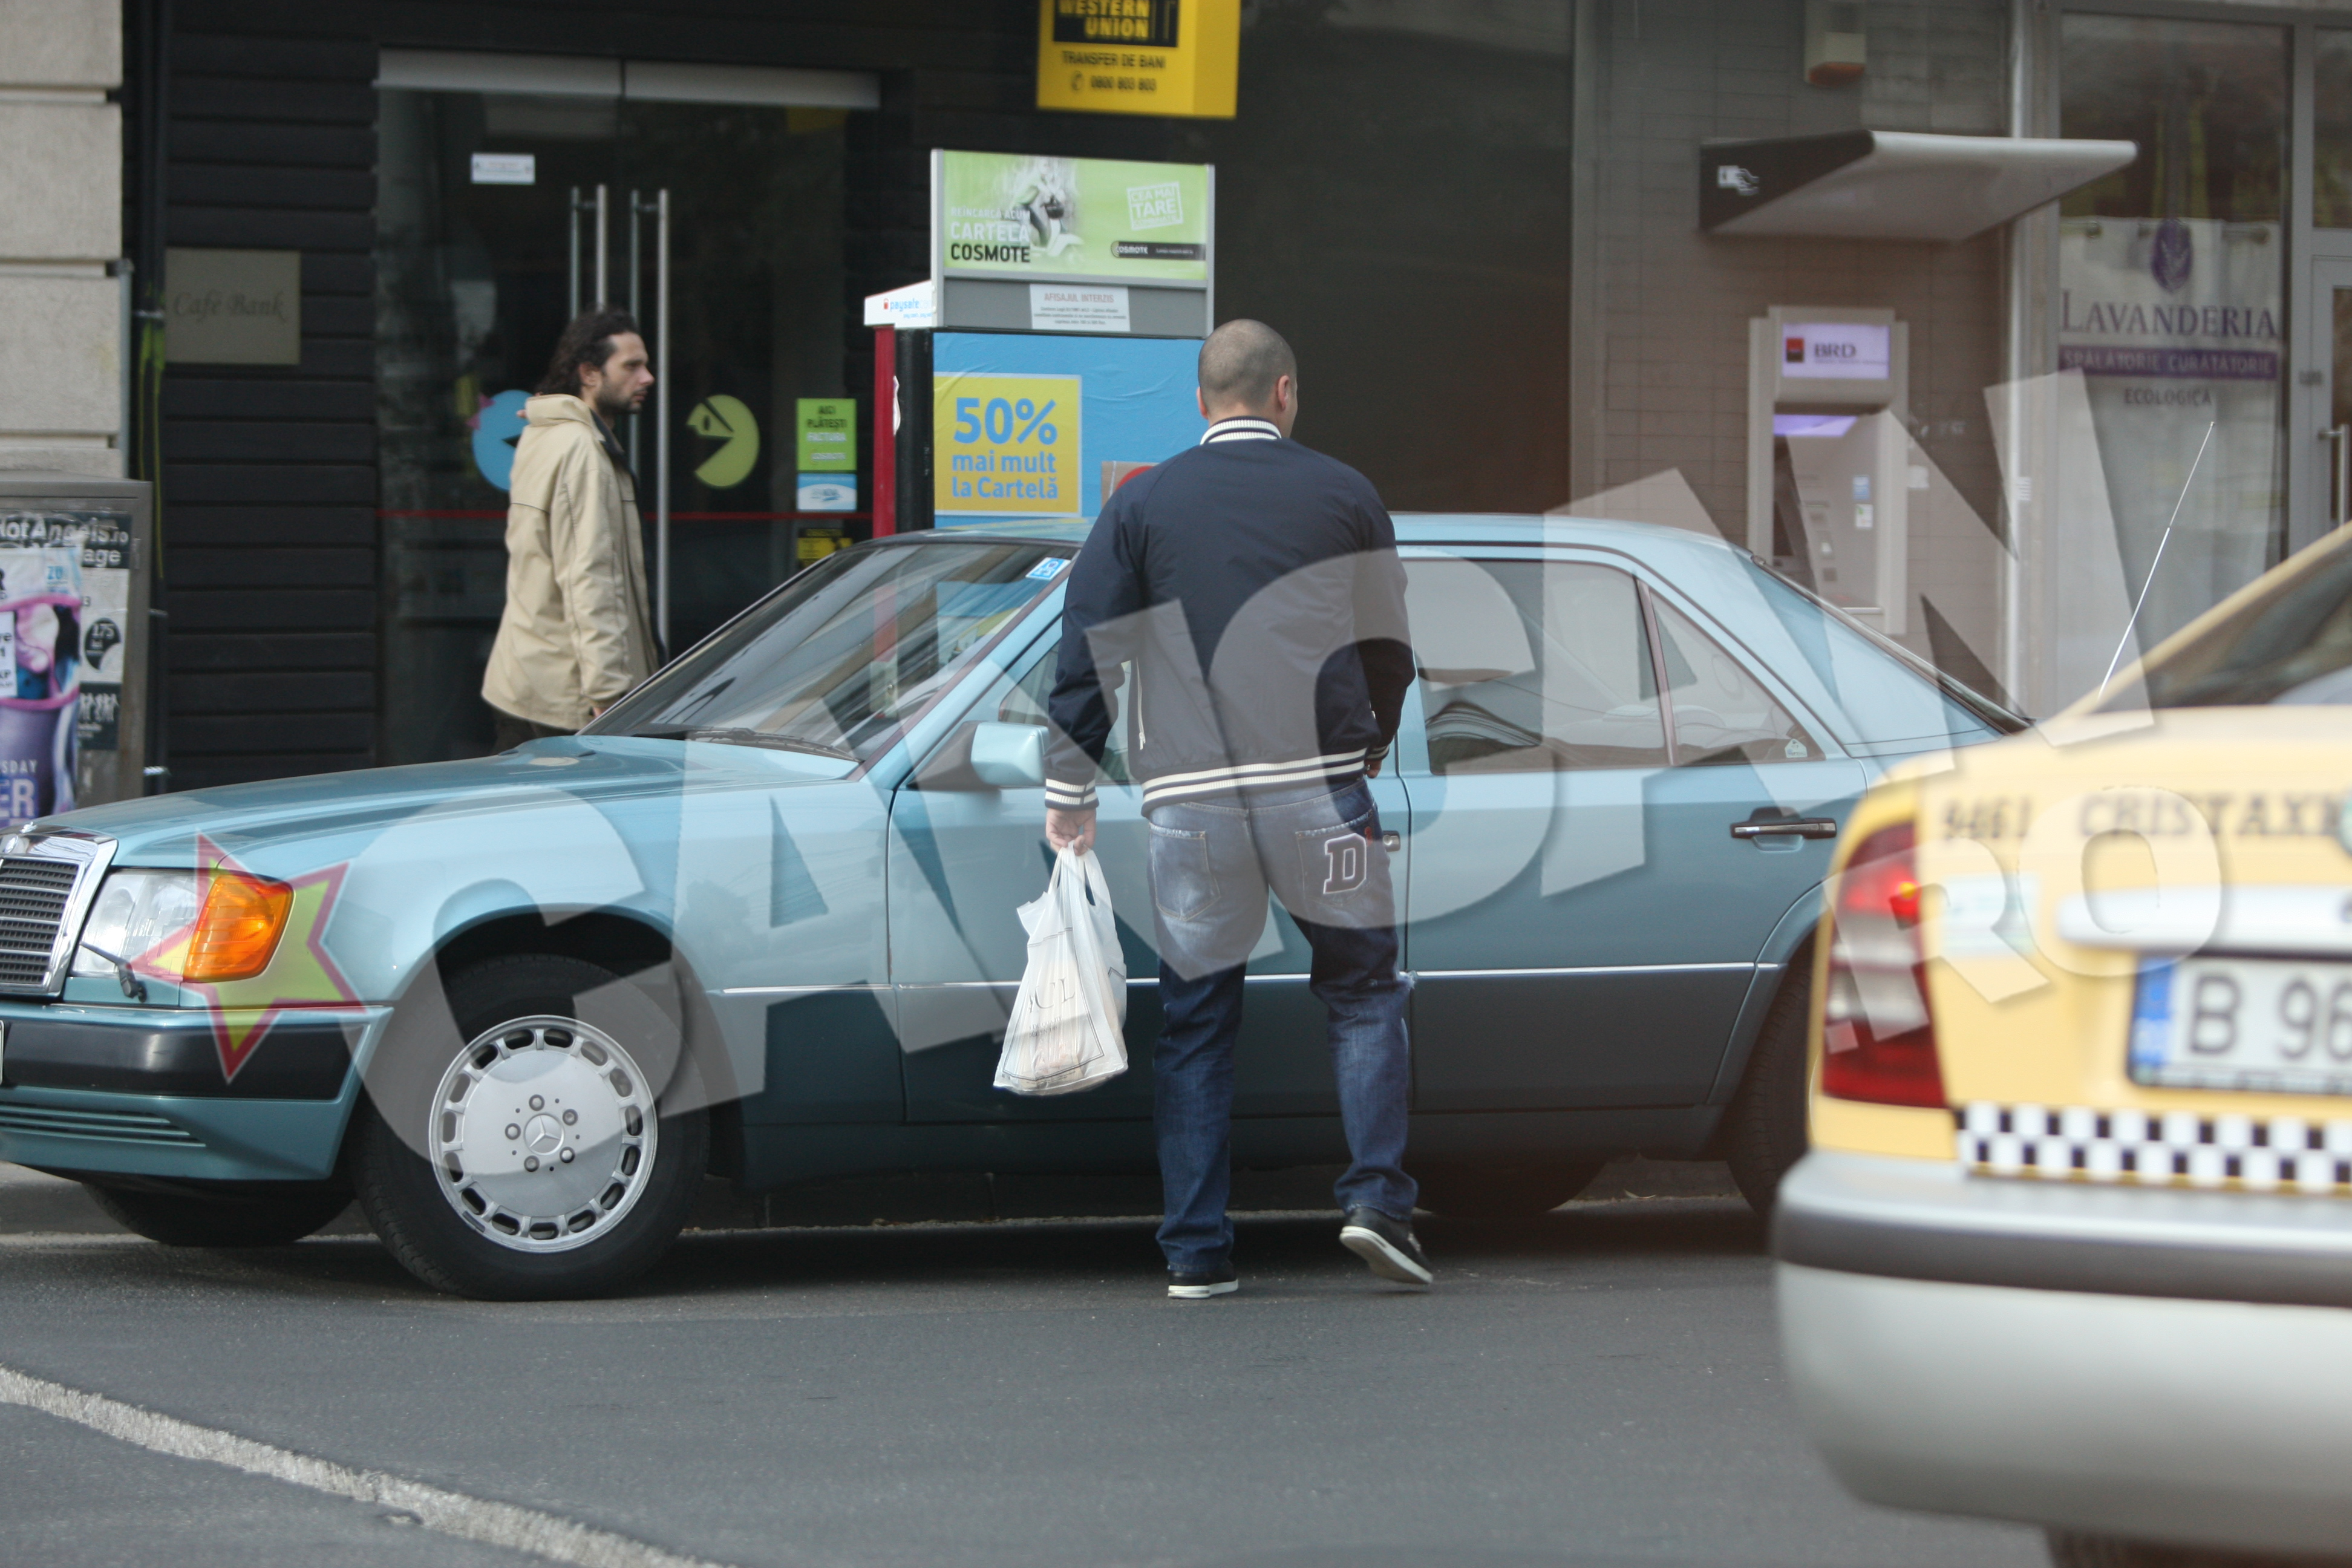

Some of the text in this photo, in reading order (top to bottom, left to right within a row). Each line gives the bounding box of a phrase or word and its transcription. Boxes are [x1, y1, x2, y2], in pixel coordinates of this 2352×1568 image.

[1085, 16, 1149, 39] UNION
[1062, 51, 1166, 68] TRANSFER DE BANI
[1132, 198, 1177, 218] TARE
[951, 221, 1030, 242] CARTELA
[951, 243, 1031, 263] COSMOTE
[1115, 245, 1148, 255] COSMOTE
[2061, 289, 2278, 338] LAVANDERIA
[1815, 343, 1857, 358] BRD
[953, 397, 1059, 445] 50%
[952, 449, 1057, 474] mai mult
[952, 476, 1059, 500] la Cartelă
[1322, 833, 1367, 895] D
[2187, 972, 2241, 1055] B
